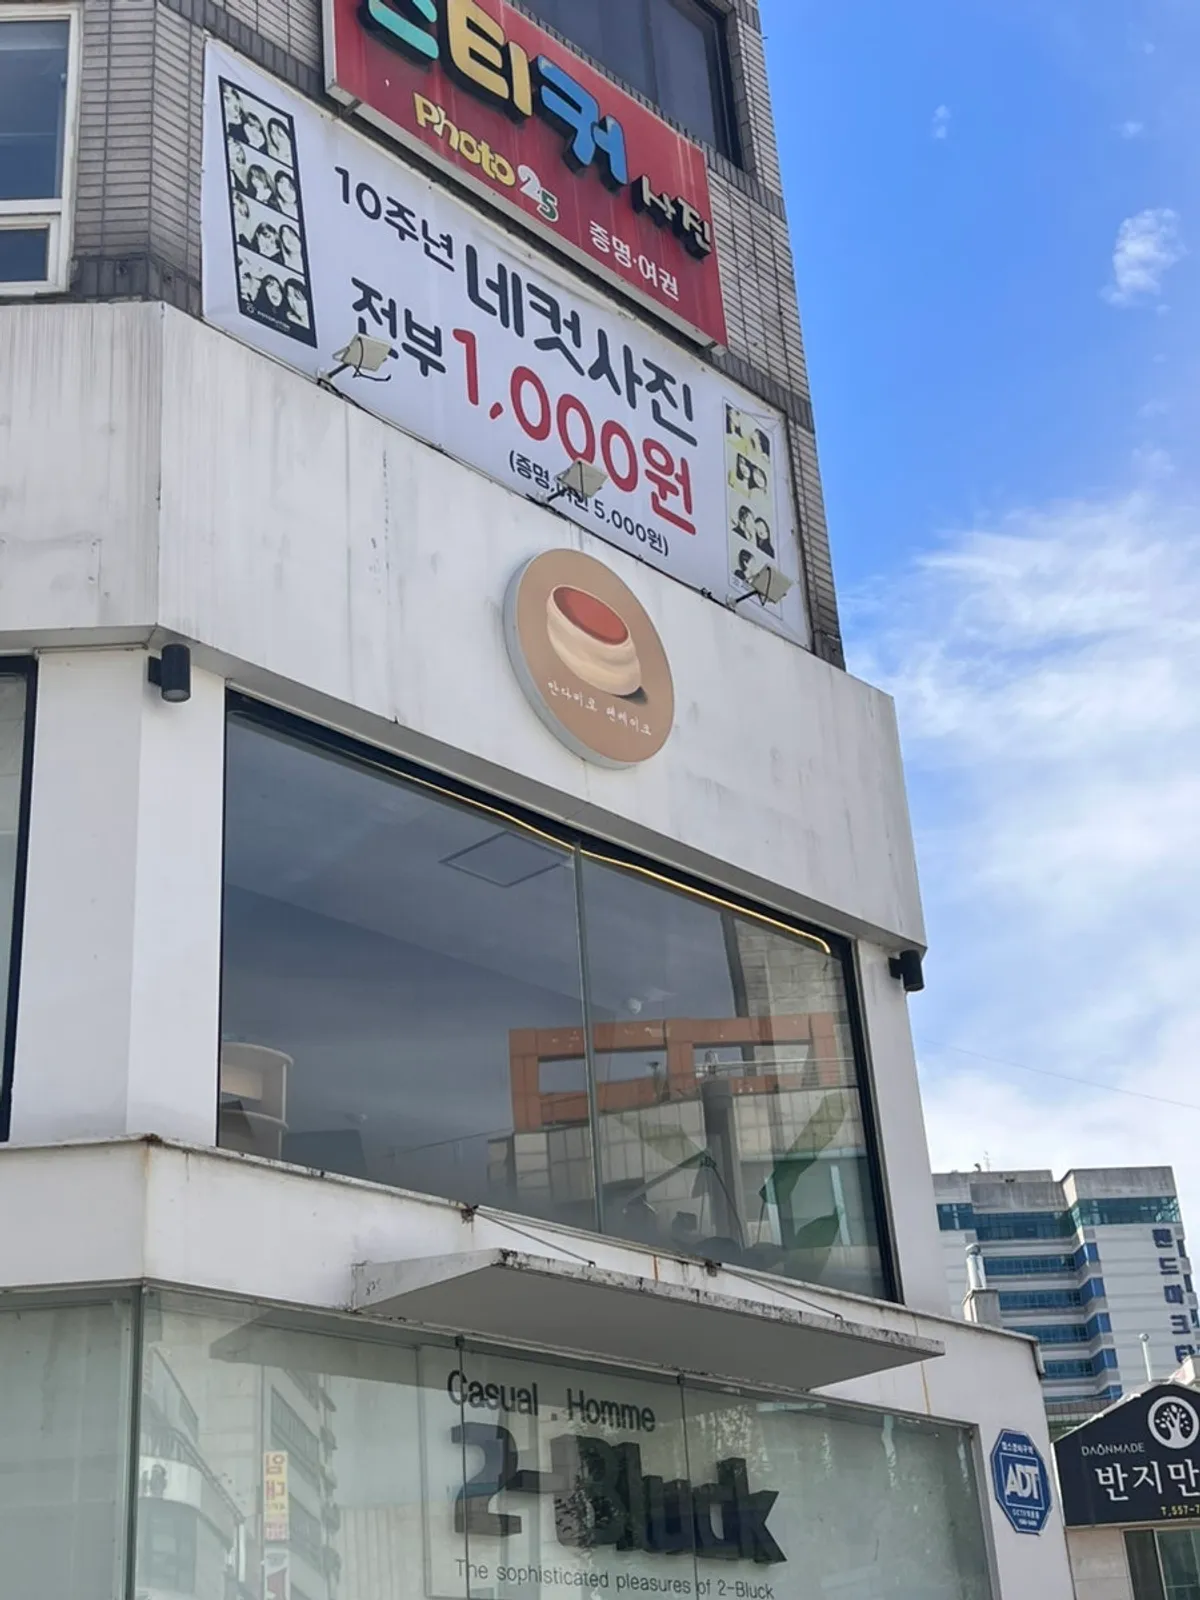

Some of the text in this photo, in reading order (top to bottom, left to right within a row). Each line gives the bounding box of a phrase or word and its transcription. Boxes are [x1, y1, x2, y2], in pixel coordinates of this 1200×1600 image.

[334, 165, 699, 448] 10주년 네컷사진
[351, 276, 697, 536] 전부 1,000원
[593, 500, 669, 557] 5,000원)
[447, 1369, 539, 1416] Casual
[566, 1387, 656, 1433] Homme
[450, 1421, 788, 1565] 2-Bluck
[1005, 1463, 1039, 1500] ADT
[1094, 1458, 1200, 1501] 반지만
[455, 1558, 775, 1600] The sophisticated pleasures of 2-Bluck
